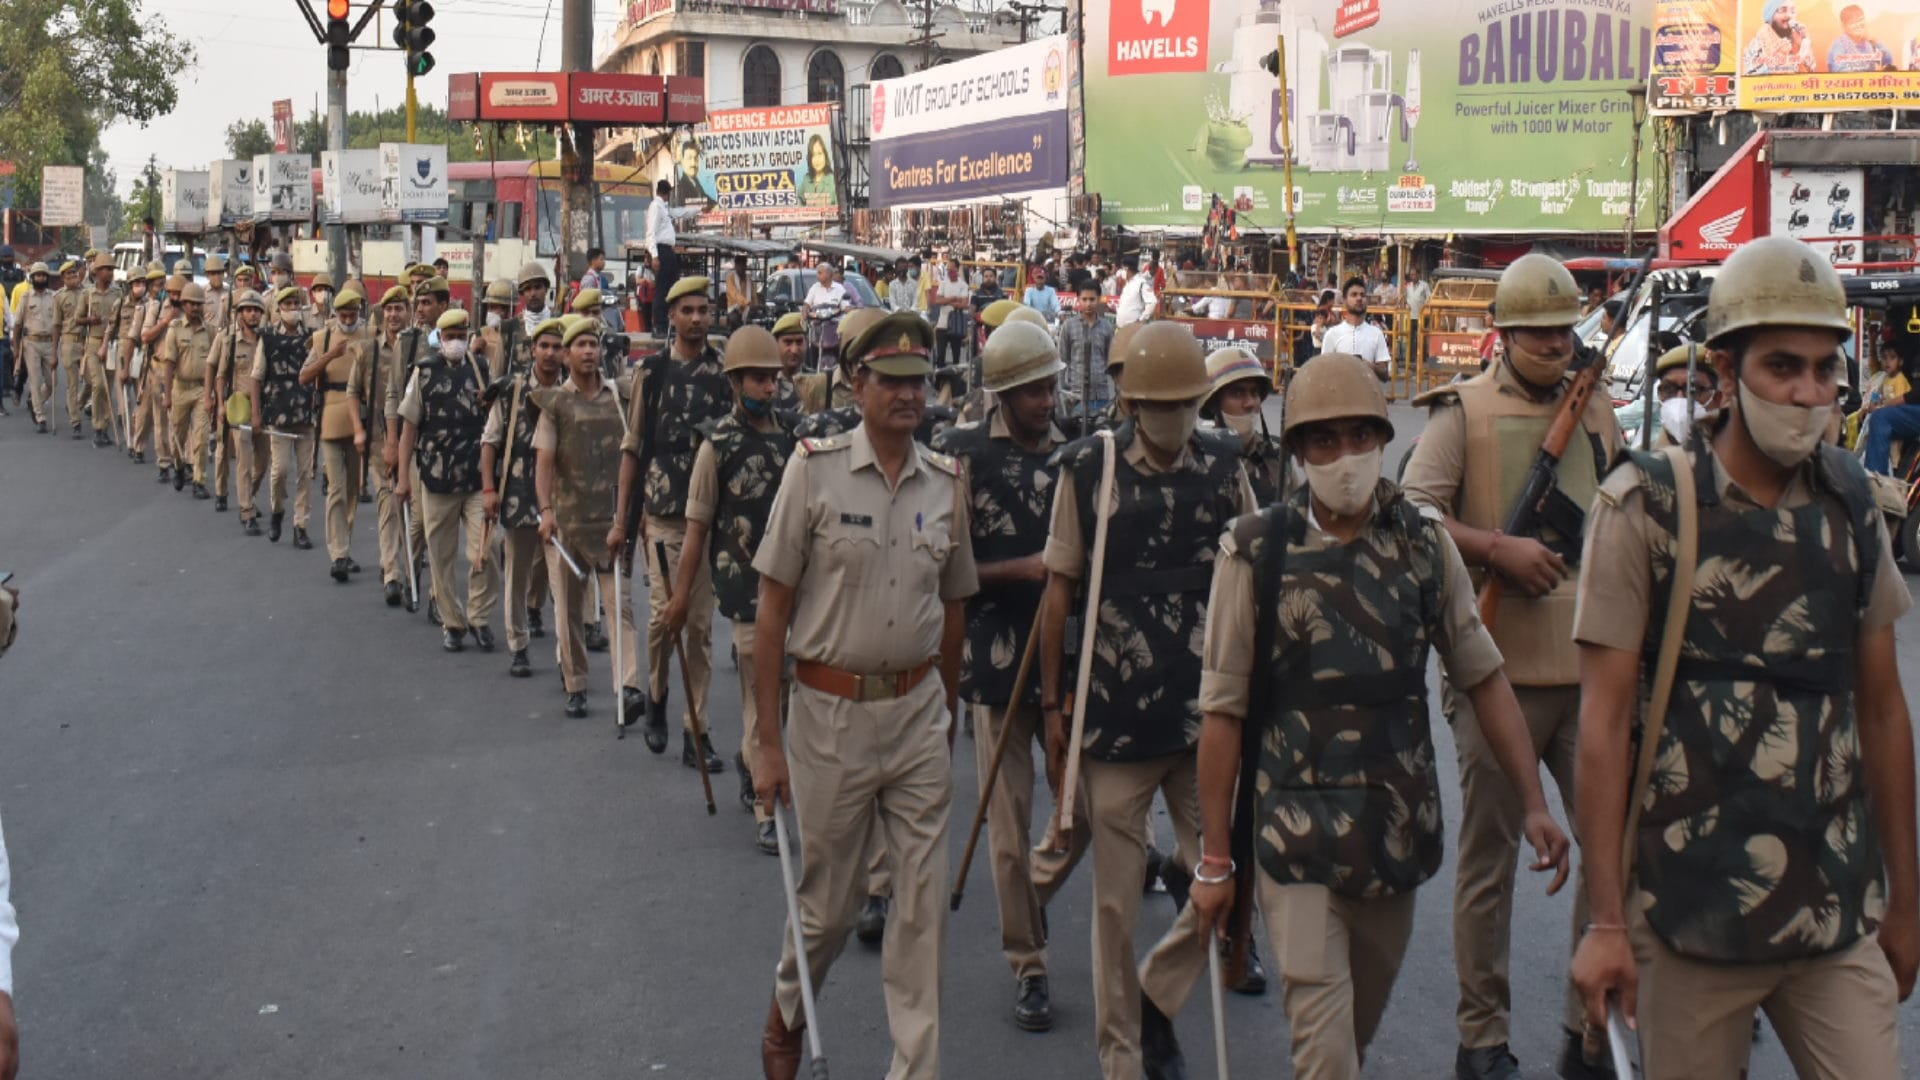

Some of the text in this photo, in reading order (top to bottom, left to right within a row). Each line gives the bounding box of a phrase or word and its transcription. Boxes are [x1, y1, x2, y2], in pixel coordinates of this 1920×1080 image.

[1117, 36, 1198, 61] HAVELLS
[579, 88, 659, 108] अमर उजाला
[925, 83, 958, 112] GROUP
[960, 78, 974, 106] OF
[976, 67, 1030, 102] SCHOOLS
[713, 112, 766, 130] DEFENCE
[770, 108, 828, 126] ACADEMY
[1455, 102, 1512, 116] Powerful
[1514, 102, 1555, 116] Juicer
[1559, 101, 1596, 115] Mixer
[1491, 119, 1613, 134] with 1000 W Motor
[769, 150, 803, 167] GROUP
[716, 171, 794, 193] GUPTA
[936, 159, 956, 184] For
[718, 192, 798, 208] CLASSES
[1510, 179, 1566, 201] Strongest
[1870, 280, 1900, 290] BOSS
